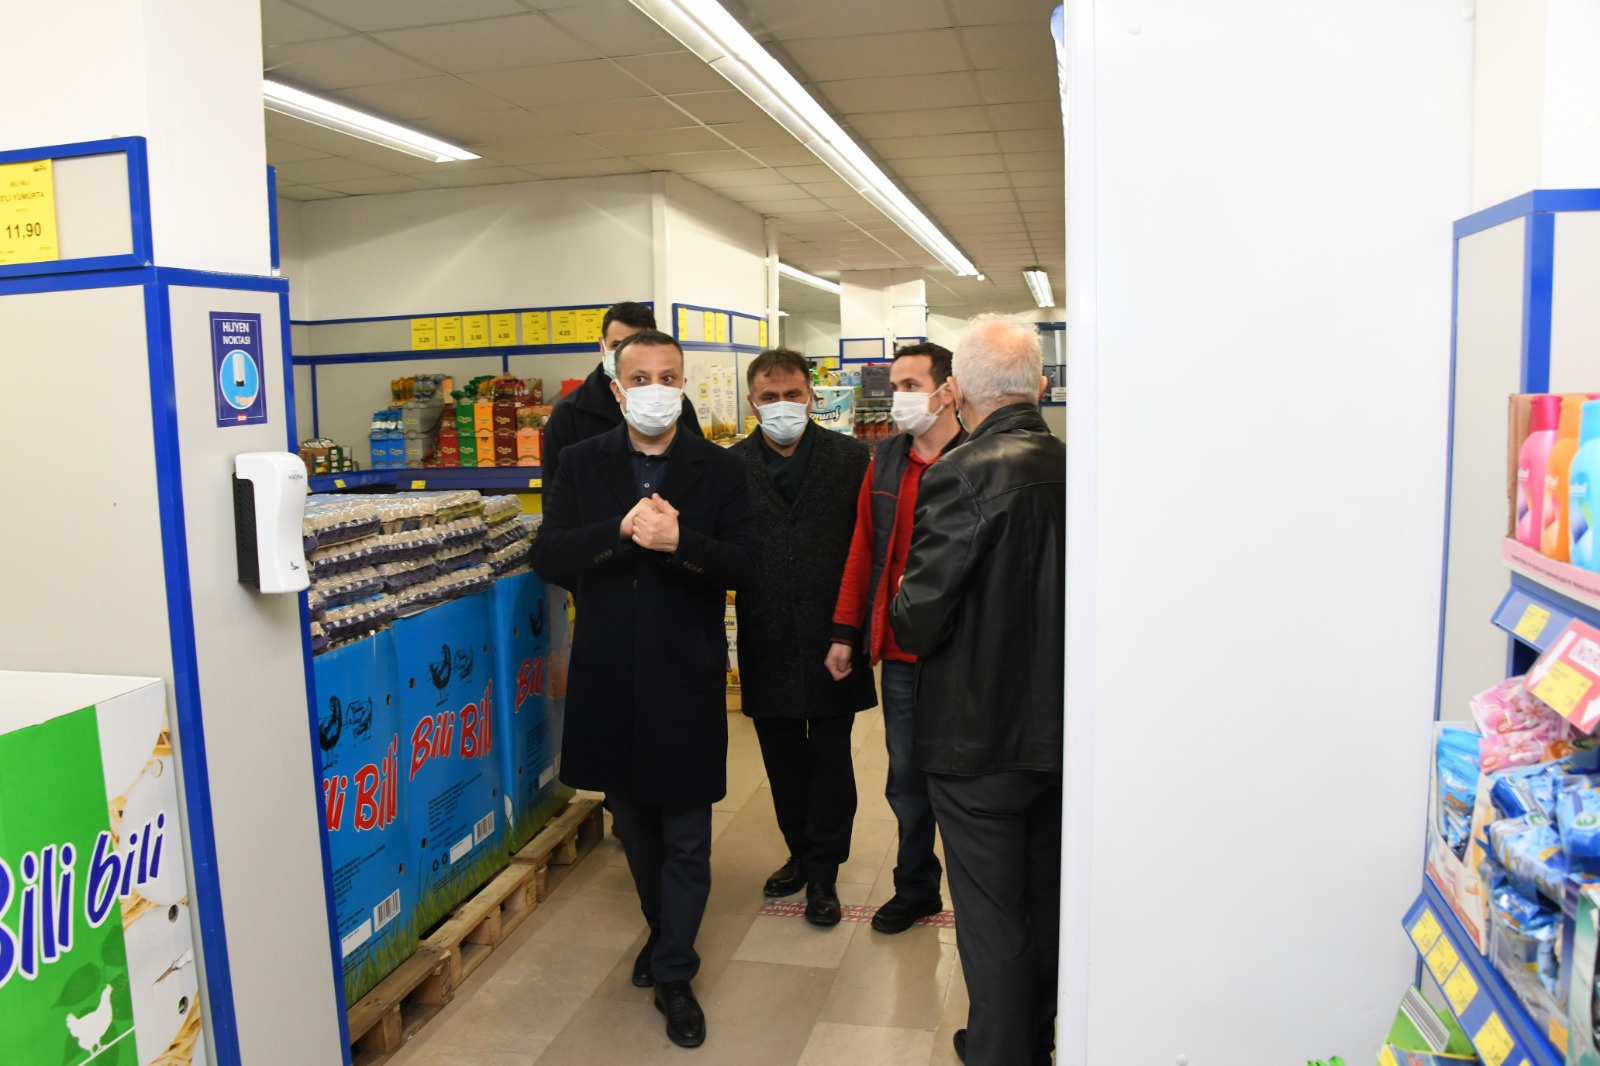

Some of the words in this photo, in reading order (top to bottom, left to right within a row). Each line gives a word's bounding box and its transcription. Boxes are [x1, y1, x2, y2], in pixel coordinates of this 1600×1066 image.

[6, 222, 42, 240] 11,90
[223, 335, 251, 345] NOKTASI
[514, 656, 546, 714] Bili
[409, 710, 455, 781] Bili
[459, 679, 492, 760] Bili
[353, 733, 398, 832] Bili
[85, 812, 166, 928] bili
